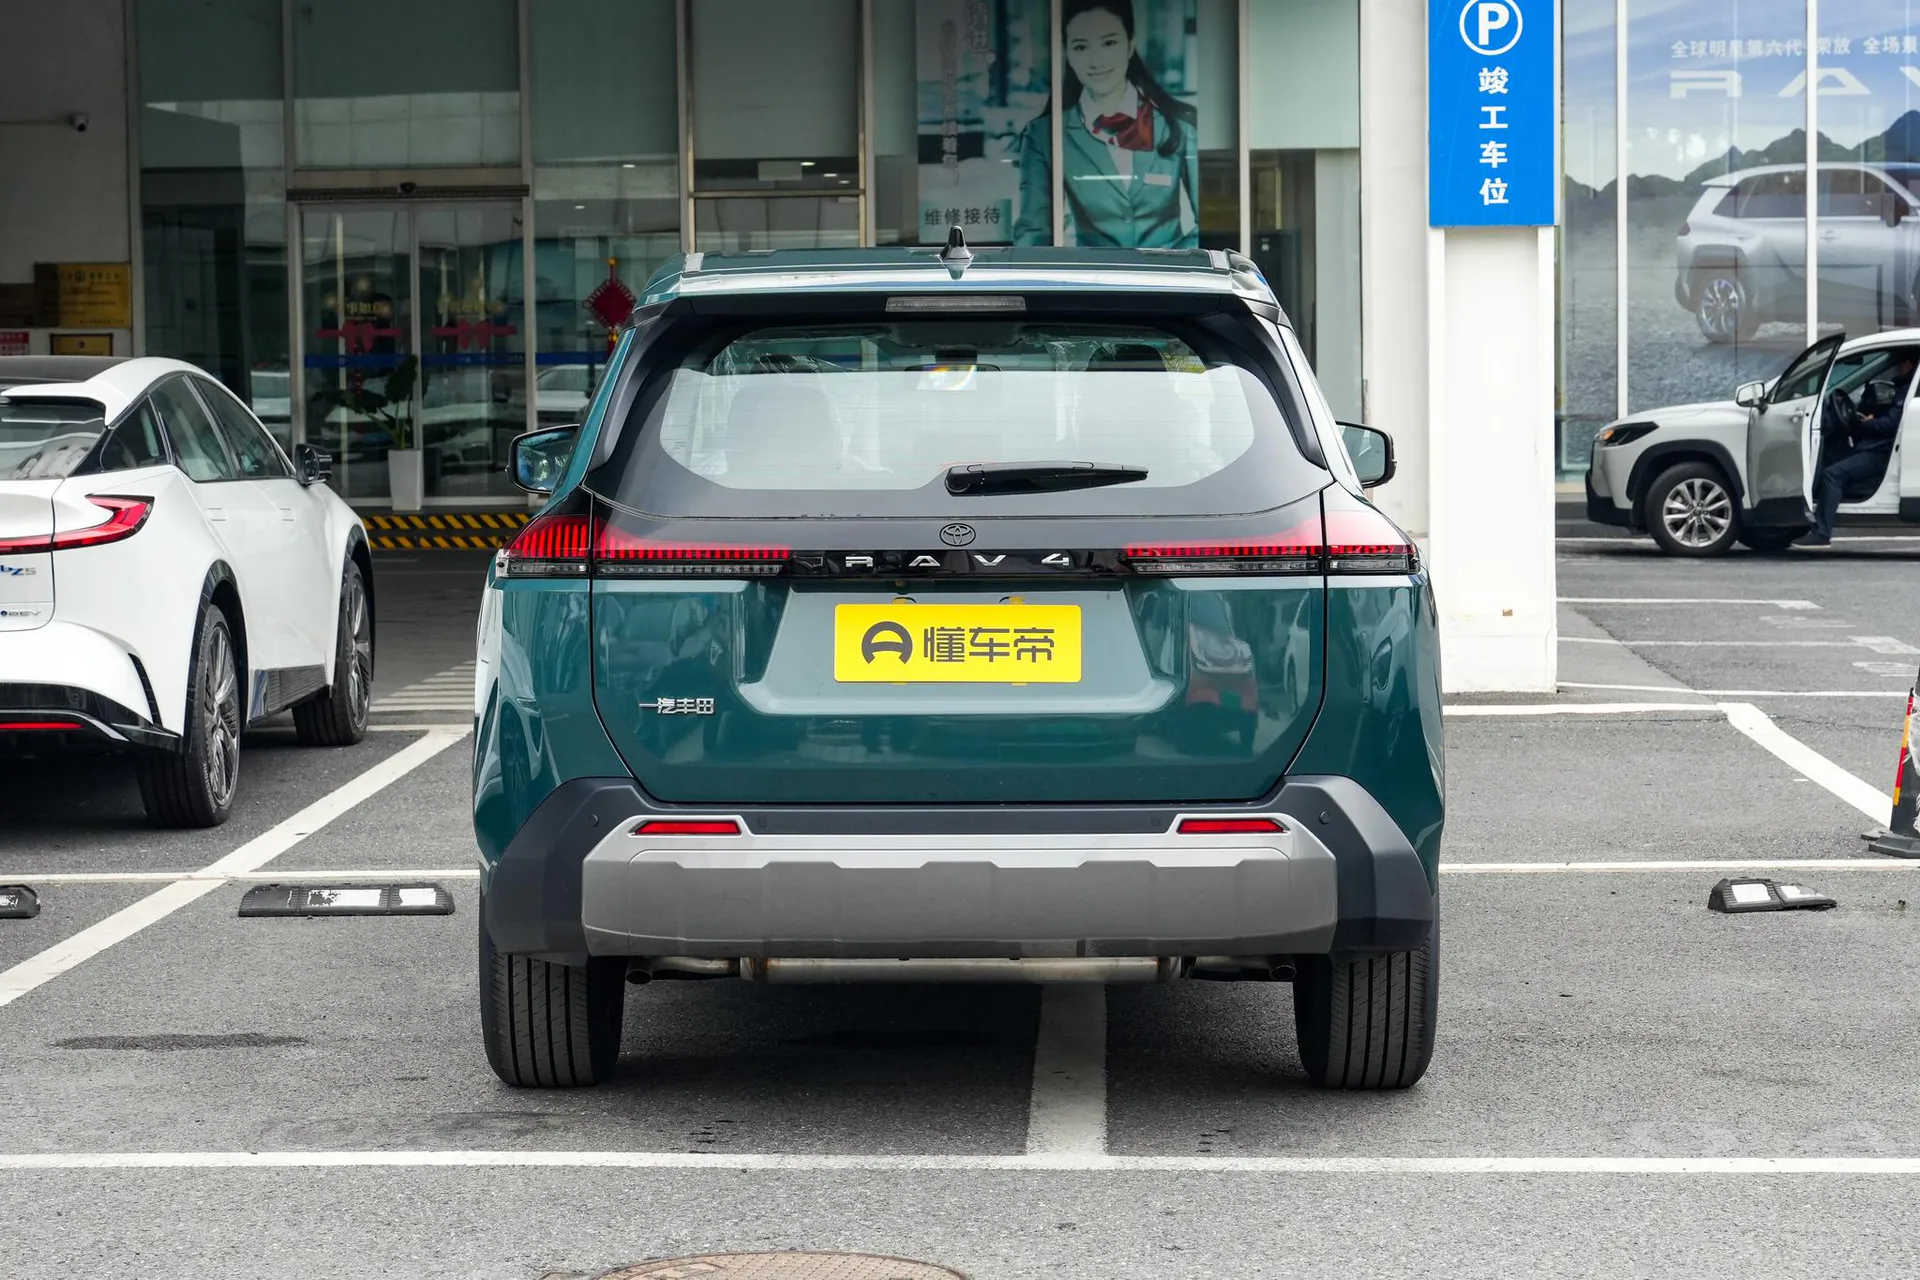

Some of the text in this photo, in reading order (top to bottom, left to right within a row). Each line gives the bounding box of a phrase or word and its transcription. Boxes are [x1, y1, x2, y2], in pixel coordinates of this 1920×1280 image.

[1478, 3, 1510, 46] P
[1670, 66, 1920, 99] RA
[1478, 66, 1509, 206] 竣工车位
[924, 207, 1001, 226] 维修接待
[845, 553, 1070, 568] RAV4
[923, 626, 1055, 663] 懂车帝
[638, 697, 715, 714] 一汽丰田
